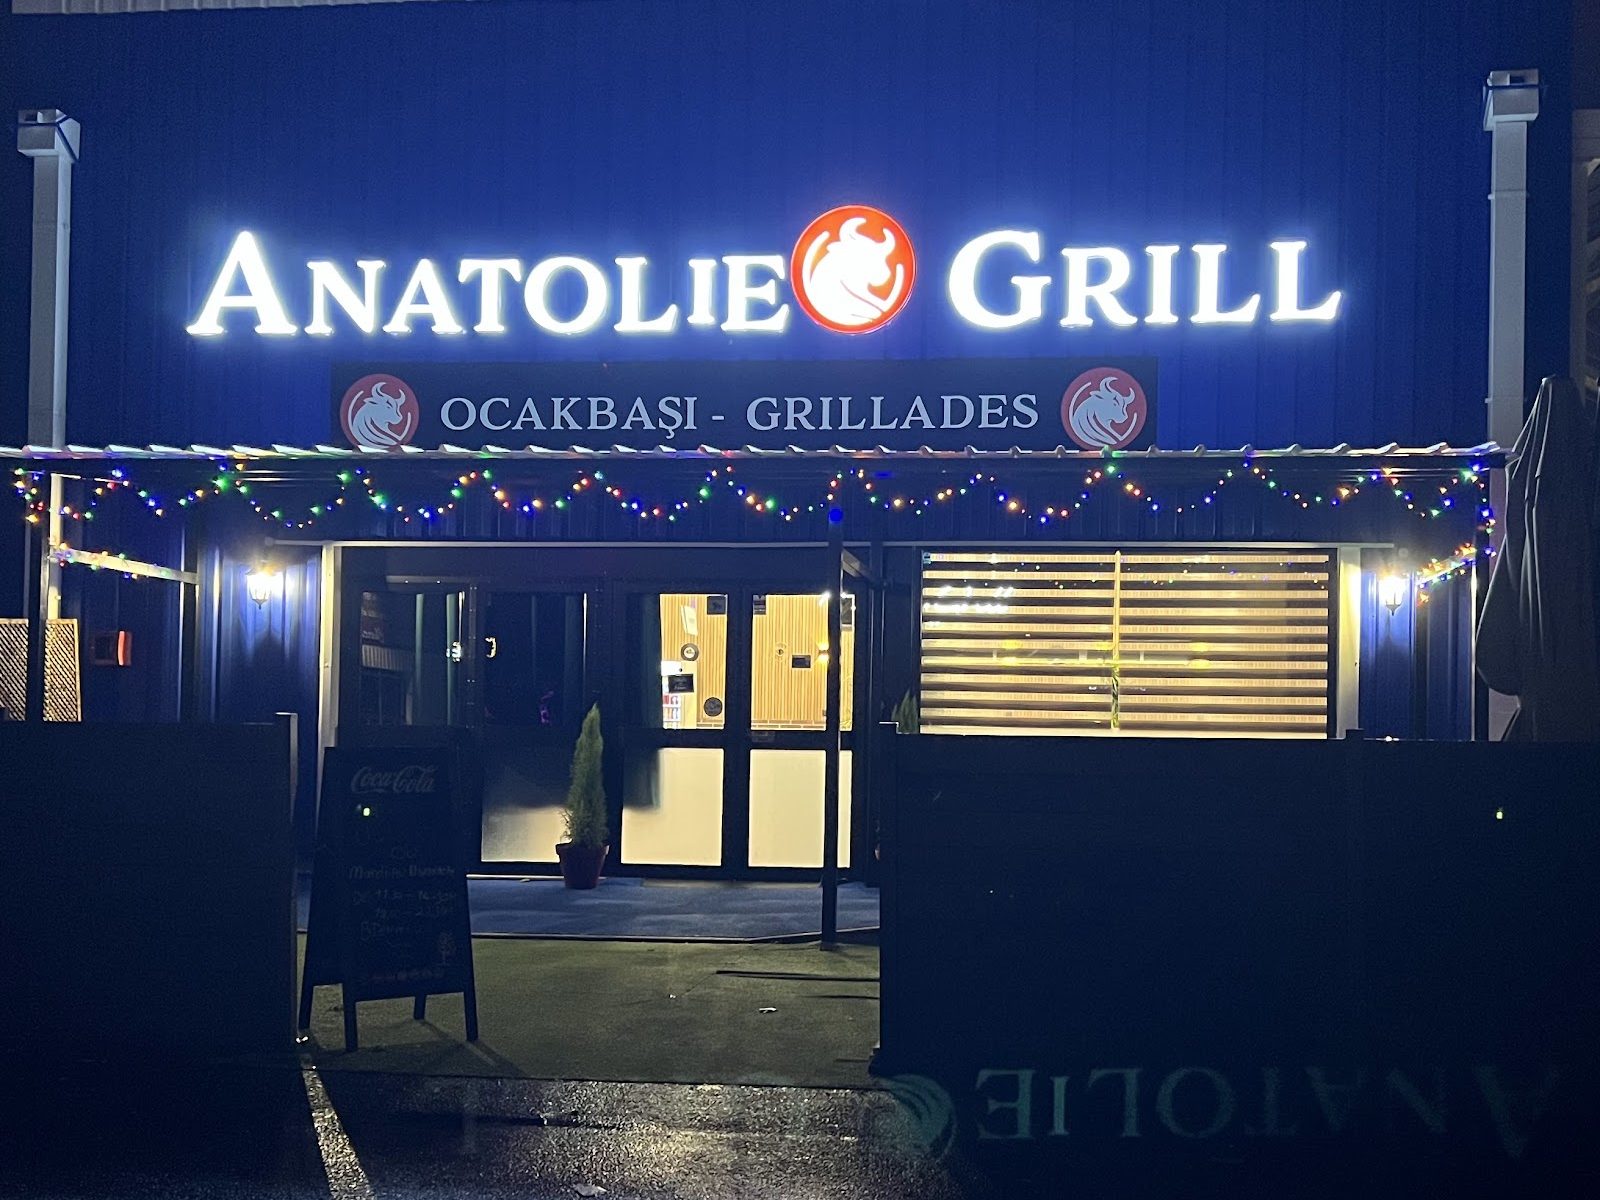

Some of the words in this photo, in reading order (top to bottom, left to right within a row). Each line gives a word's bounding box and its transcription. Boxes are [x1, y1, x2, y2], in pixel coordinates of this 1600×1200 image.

[185, 229, 790, 336] ANATOLIE
[948, 230, 1344, 329] GRILL
[440, 396, 698, 440] OCAKBAŞI
[746, 393, 1039, 432] GRILLADES
